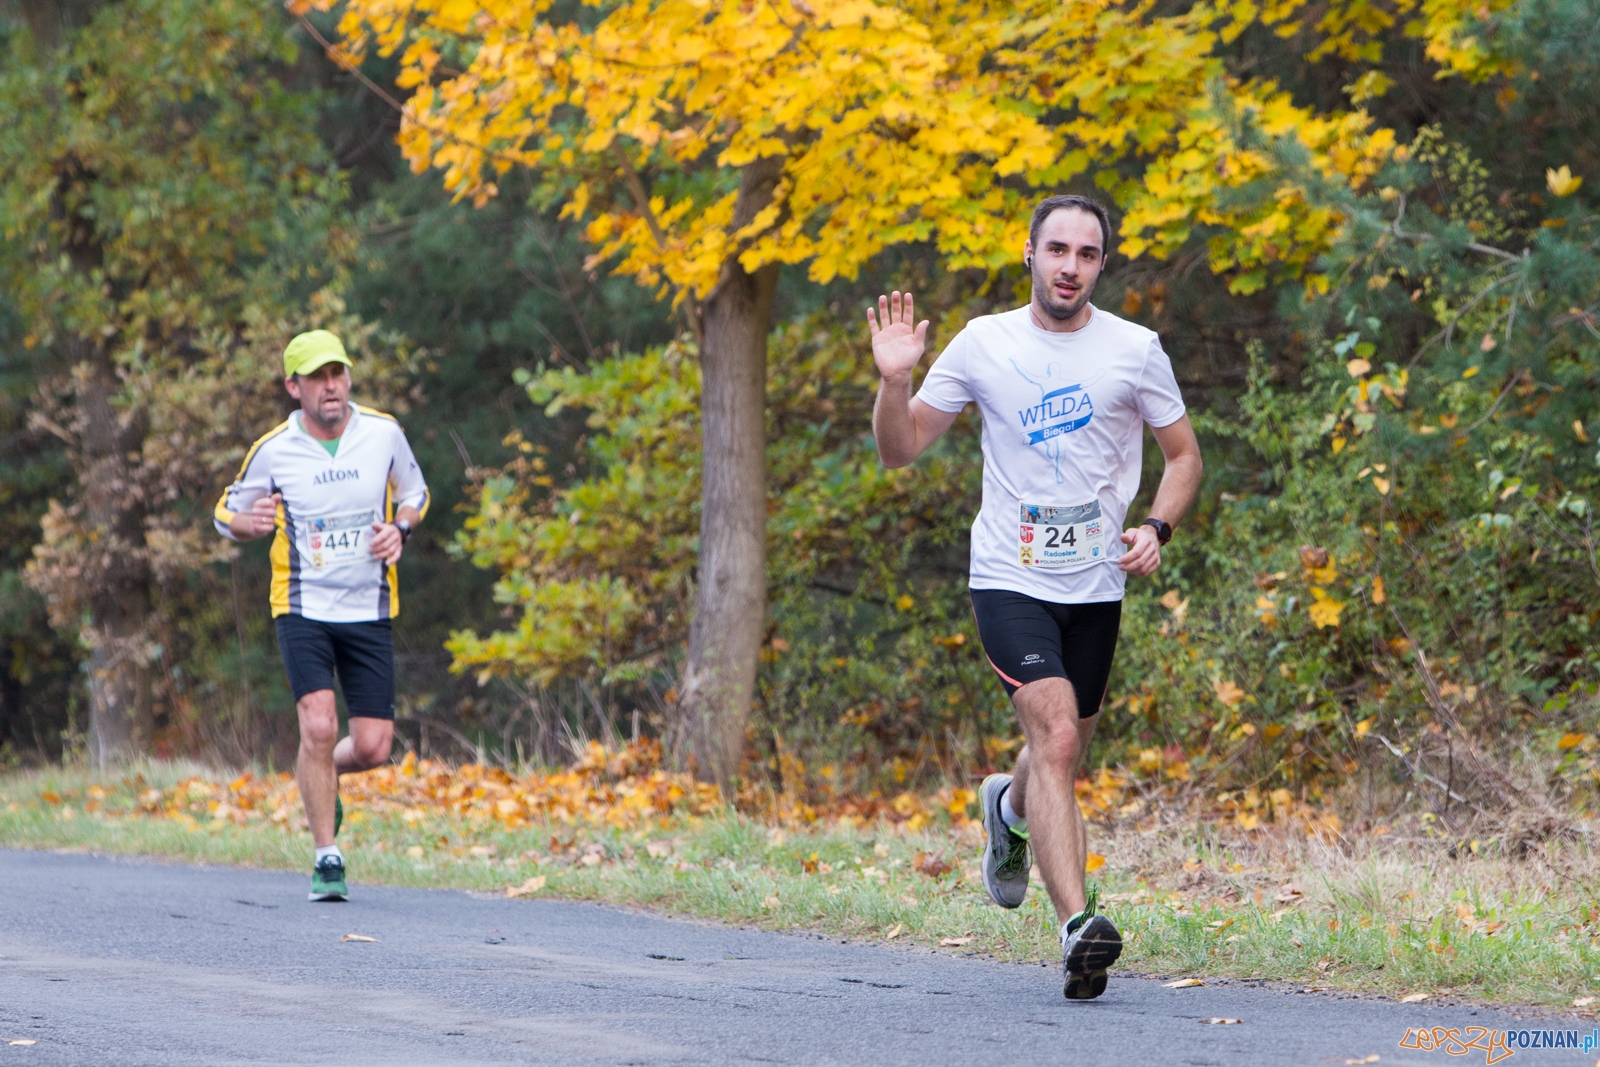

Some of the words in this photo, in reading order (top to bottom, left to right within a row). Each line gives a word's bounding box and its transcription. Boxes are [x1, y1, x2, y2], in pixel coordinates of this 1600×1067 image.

[1018, 392, 1093, 427] WILDA
[325, 530, 361, 550] 447
[1045, 526, 1077, 548] 24
